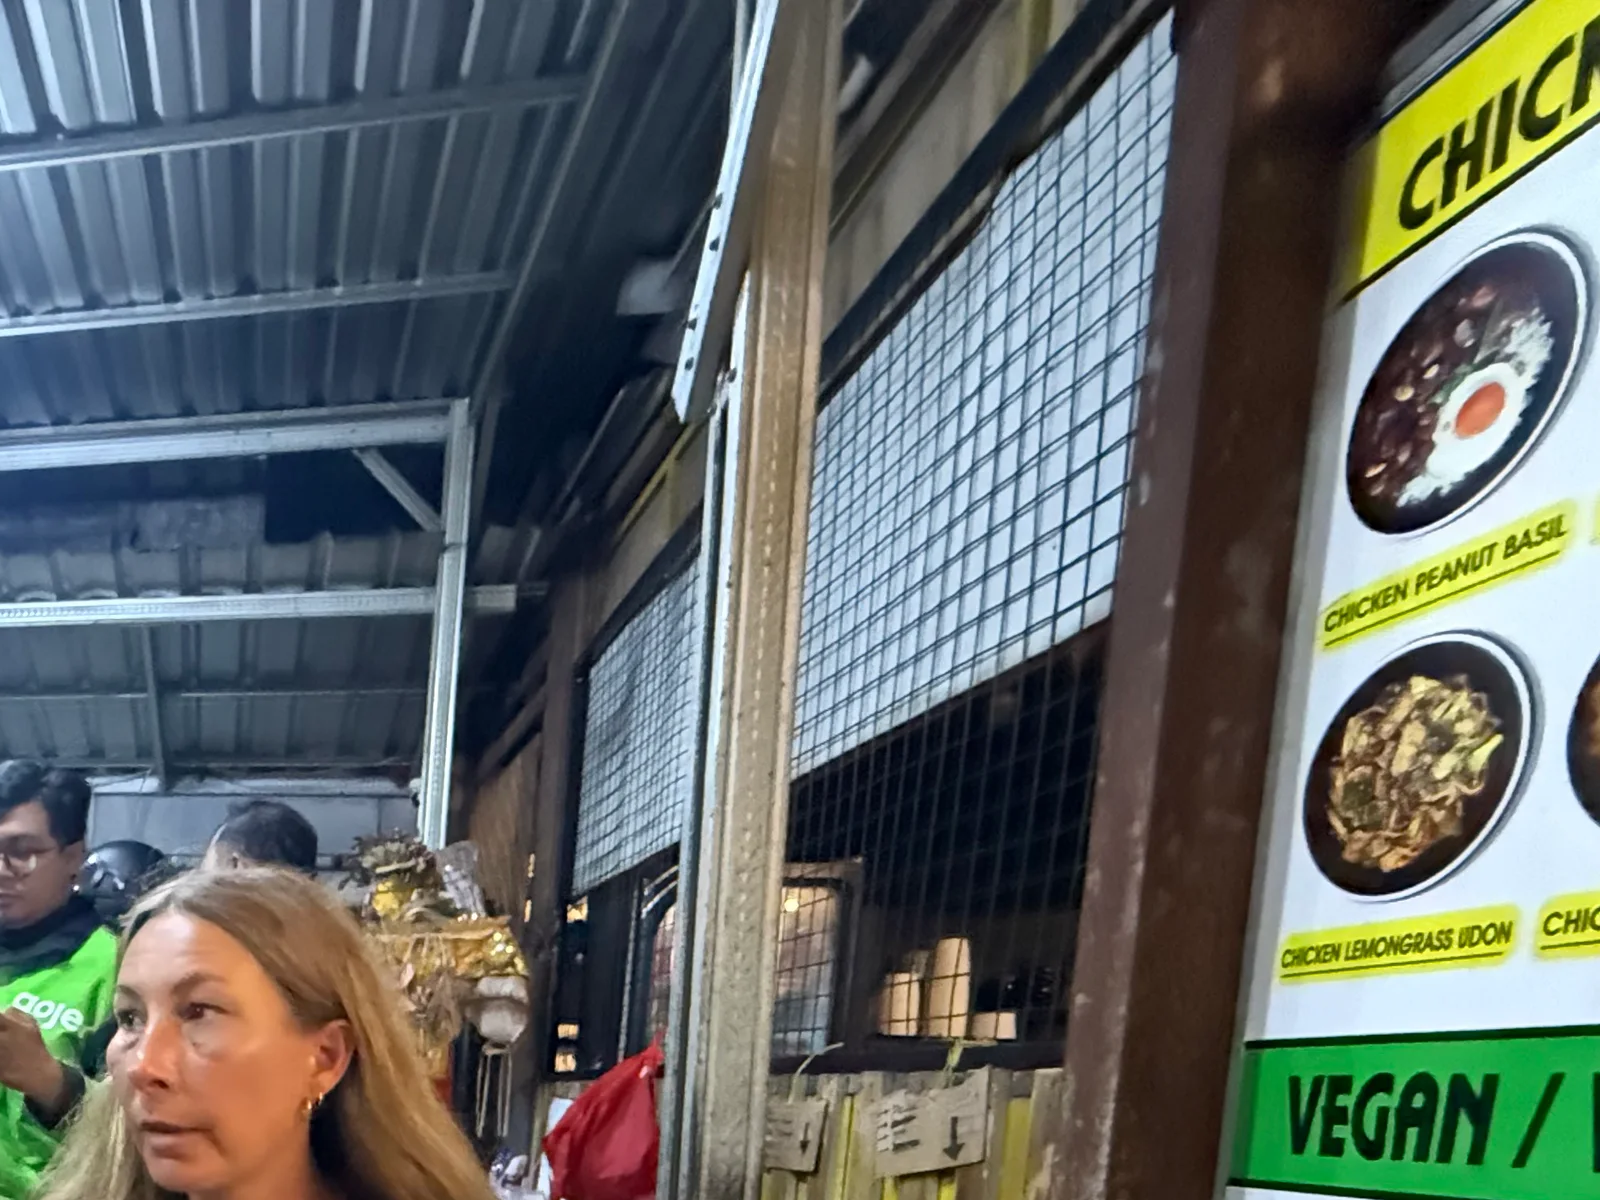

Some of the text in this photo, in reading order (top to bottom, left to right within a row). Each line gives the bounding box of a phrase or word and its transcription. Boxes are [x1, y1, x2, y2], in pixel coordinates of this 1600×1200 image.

[1324, 513, 1568, 633] CHICKEN PEANUT BASIL
[1281, 920, 1514, 969] CHICKEN LEMONGRASS UDON
[12, 991, 84, 1032] goje
[1288, 1071, 1499, 1166] VEGAN
[1510, 1072, 1566, 1168] /
